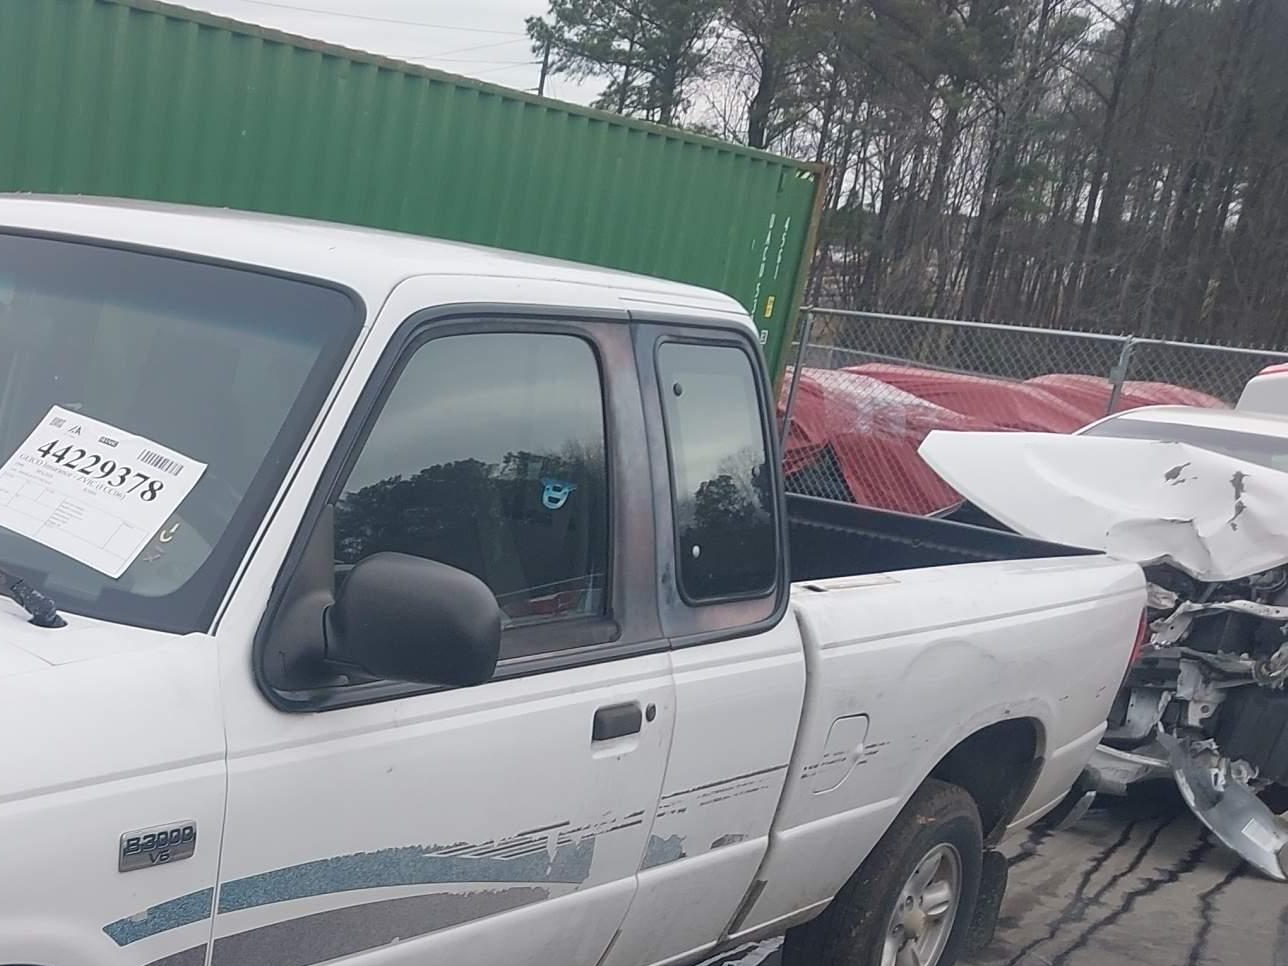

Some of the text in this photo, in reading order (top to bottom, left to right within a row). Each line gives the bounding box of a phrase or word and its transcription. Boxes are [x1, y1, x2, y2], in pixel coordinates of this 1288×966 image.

[37, 438, 166, 502] 44229378
[123, 825, 194, 857] B3000
[147, 848, 171, 865] V6
